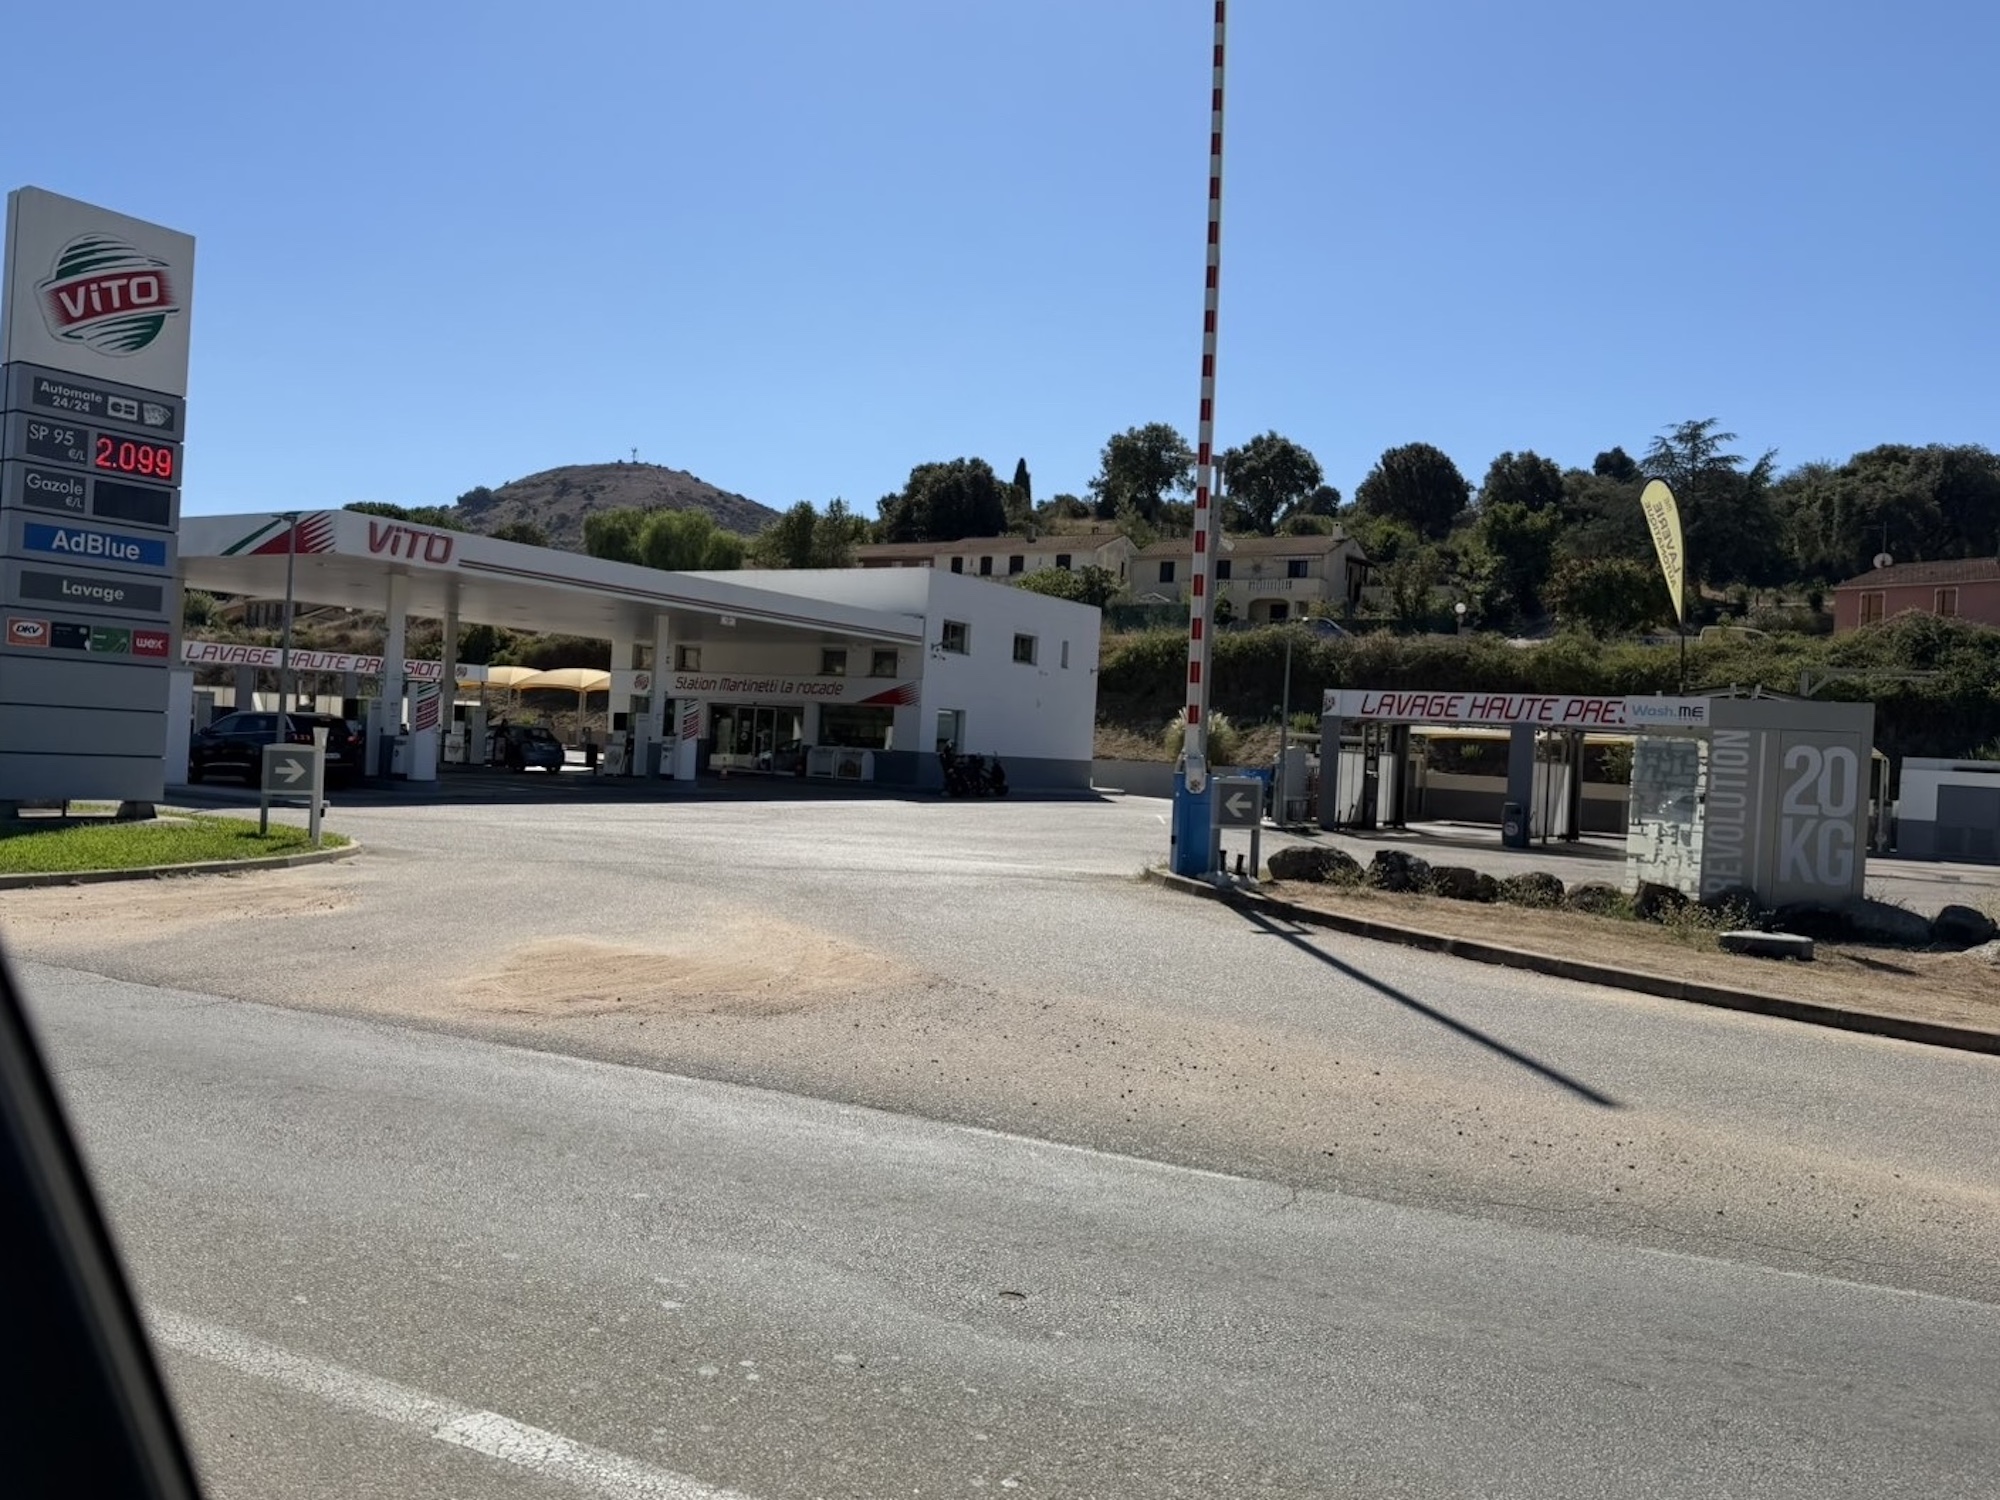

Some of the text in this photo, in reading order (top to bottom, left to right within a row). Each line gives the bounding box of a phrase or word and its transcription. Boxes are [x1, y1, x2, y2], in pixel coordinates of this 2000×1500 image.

[40, 381, 103, 402] Automate
[52, 395, 90, 412] 24/24
[29, 423, 75, 446] SP 95
[95, 437, 172, 477] 2.099
[26, 473, 83, 496] Gazole
[52, 531, 140, 560] AdBlue
[62, 579, 124, 602] Lavage
[16, 625, 40, 634] DKV
[186, 644, 277, 665] LAVAGE
[675, 677, 717, 690] Station
[719, 678, 778, 692] Martinetti
[1361, 694, 1463, 717] LAVAGE
[1468, 697, 1558, 721] HAUTE
[1783, 745, 1859, 817] 20
[1779, 817, 1855, 887] KG
